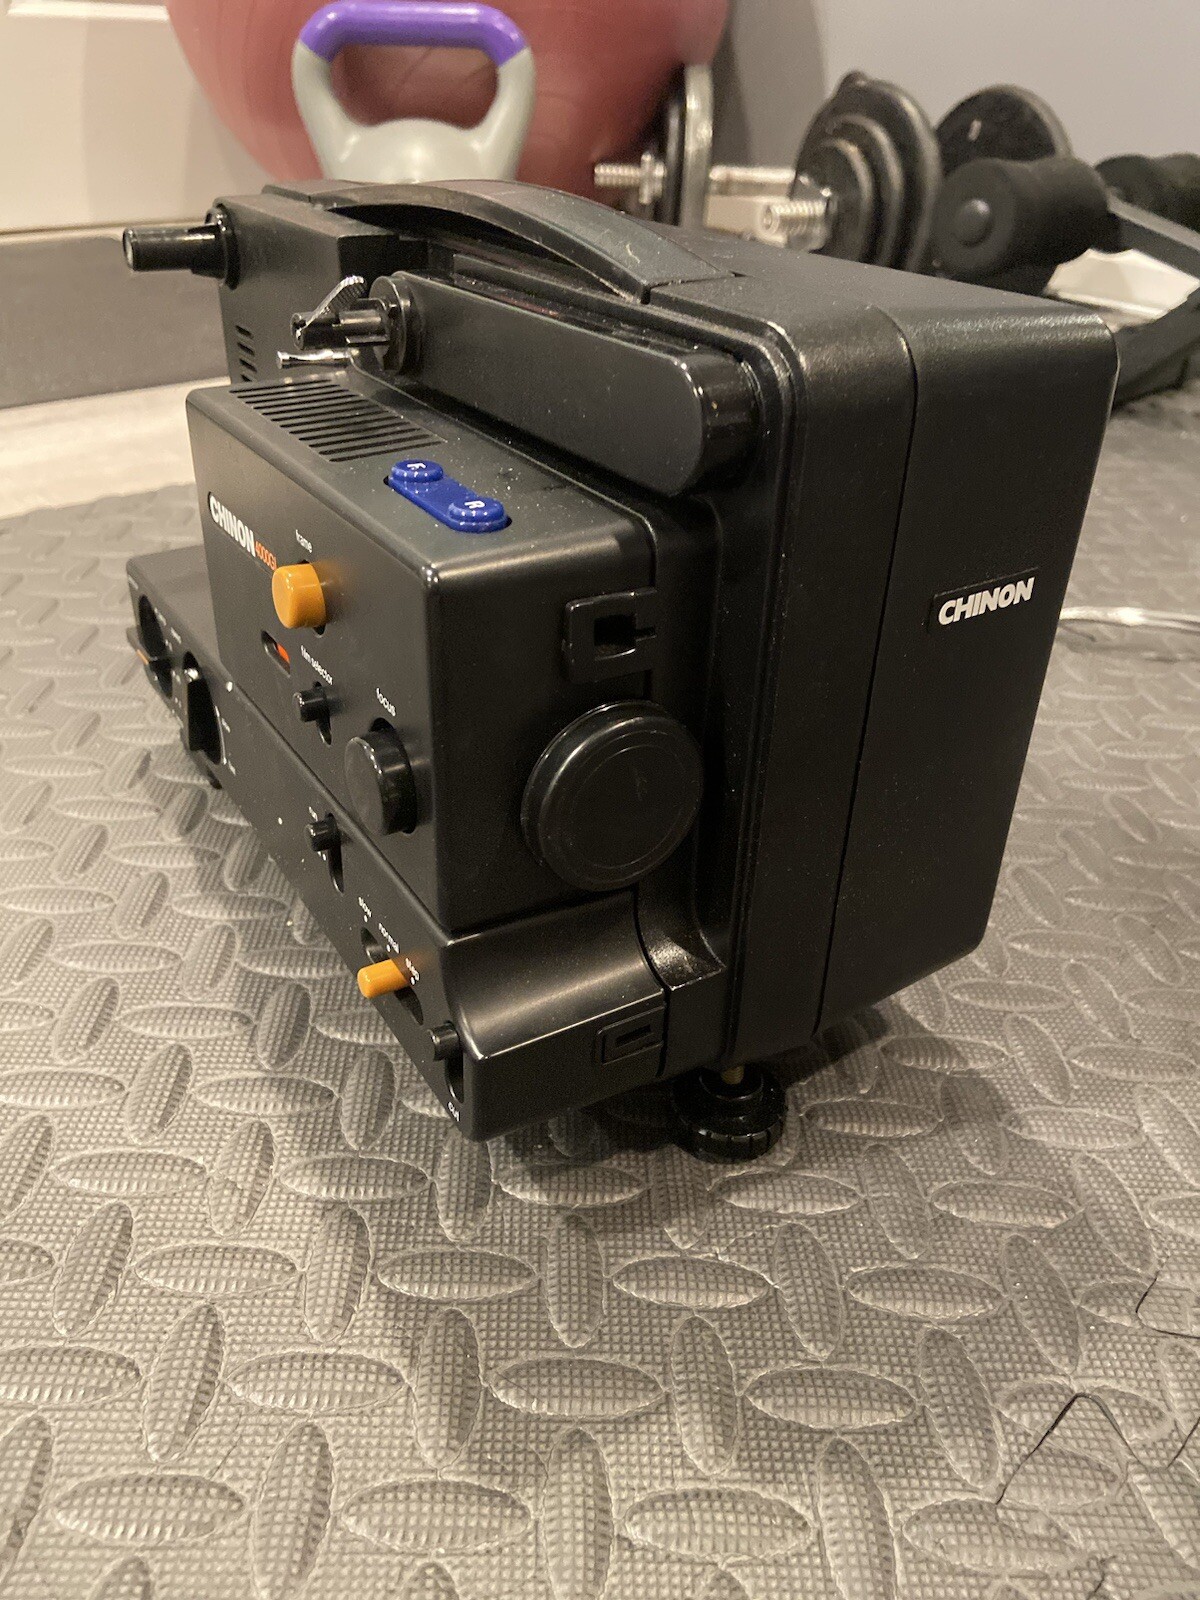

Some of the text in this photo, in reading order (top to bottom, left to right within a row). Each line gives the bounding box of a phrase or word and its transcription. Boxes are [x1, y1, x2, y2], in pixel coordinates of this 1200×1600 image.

[209, 495, 256, 557] CHINON
[464, 500, 485, 509] R
[938, 577, 1035, 625] CHINON
